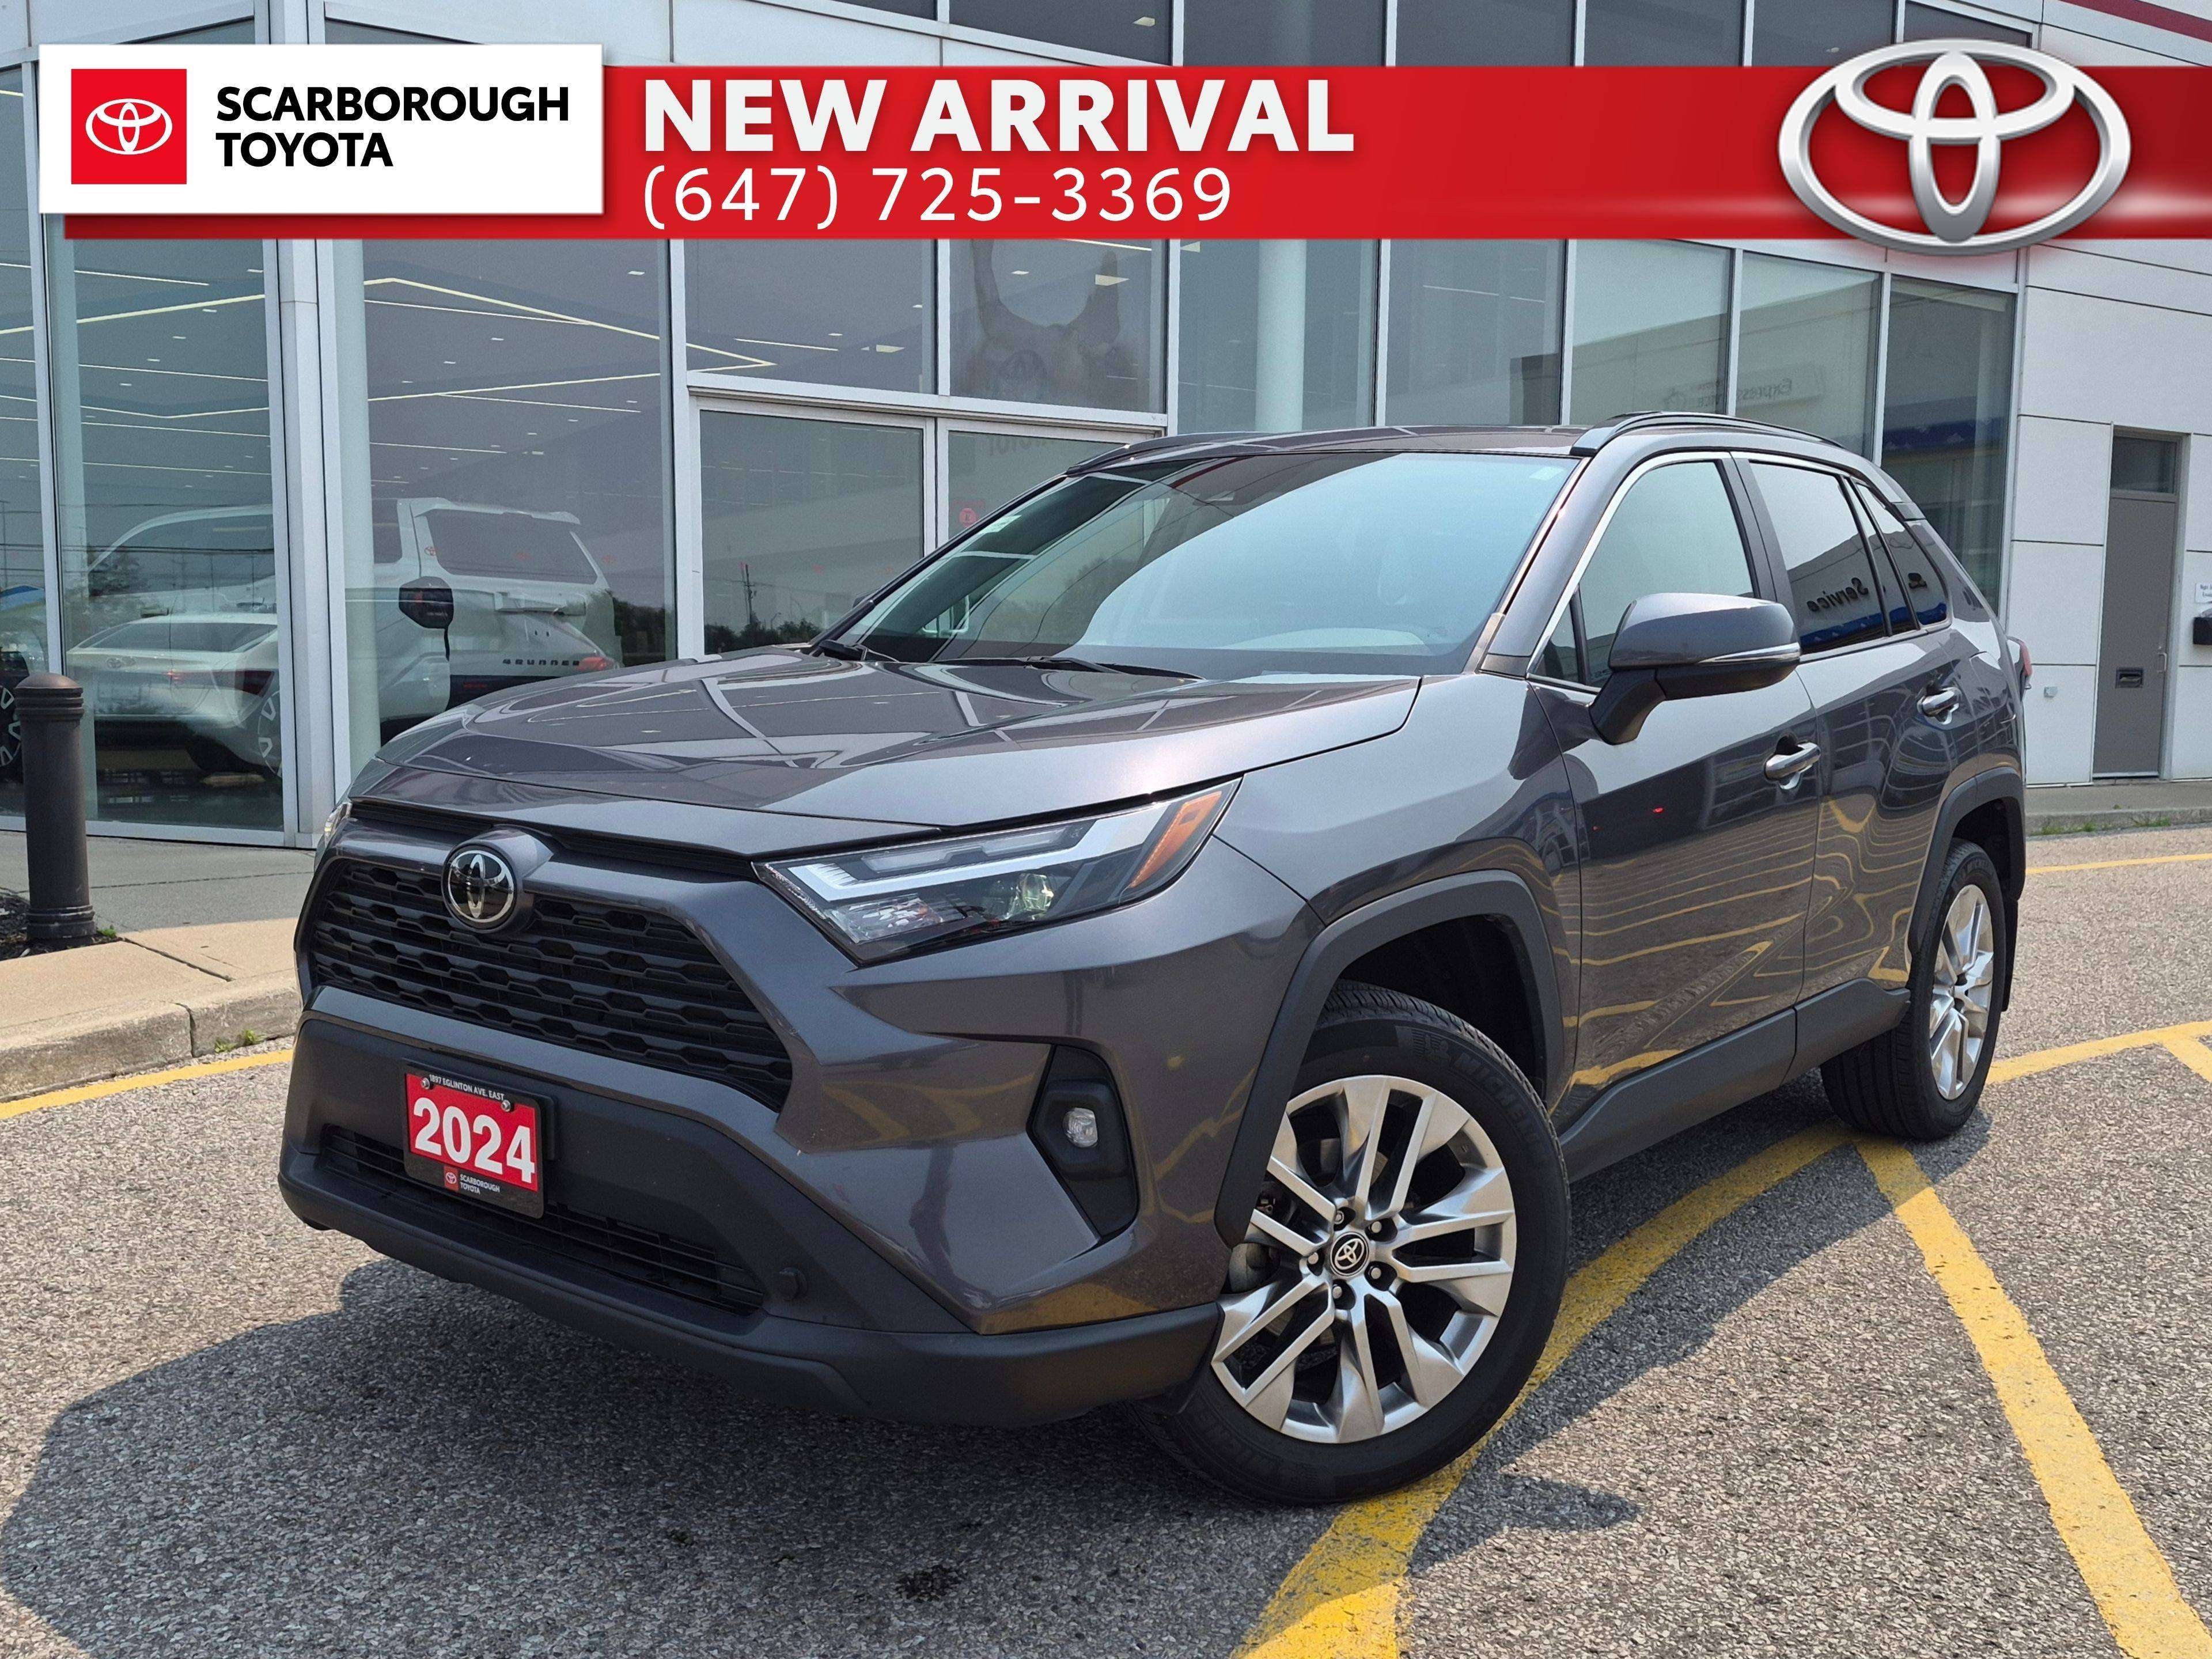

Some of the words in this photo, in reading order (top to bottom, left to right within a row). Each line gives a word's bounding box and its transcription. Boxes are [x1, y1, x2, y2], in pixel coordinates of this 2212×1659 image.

[442, 1078, 472, 1093] EGLINTON
[488, 1090, 505, 1101] EAST
[413, 1097, 535, 1184] 2024
[460, 1173, 500, 1193] SCARBOROUGH
[460, 1181, 480, 1195] TOYOTA
